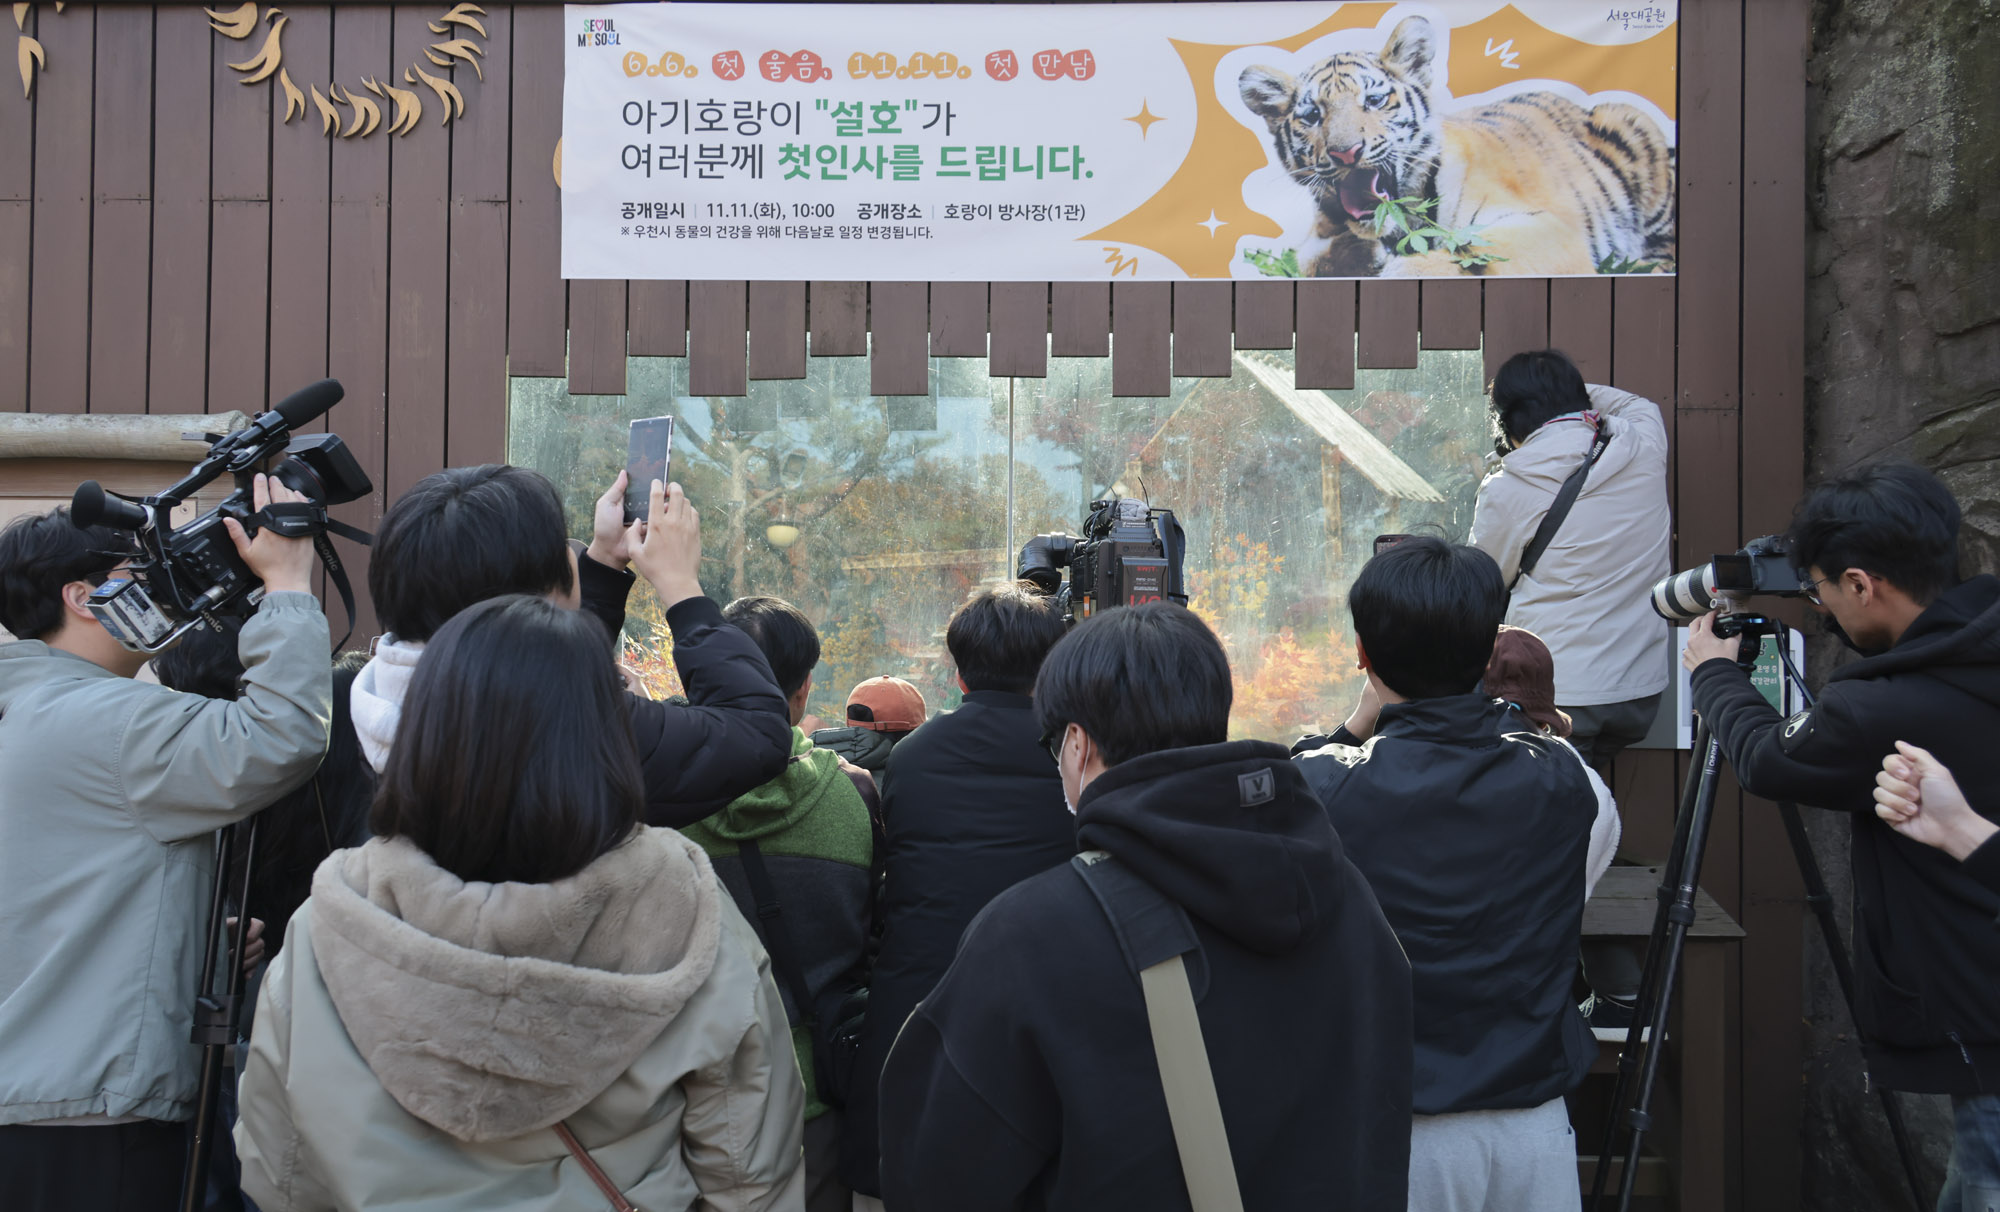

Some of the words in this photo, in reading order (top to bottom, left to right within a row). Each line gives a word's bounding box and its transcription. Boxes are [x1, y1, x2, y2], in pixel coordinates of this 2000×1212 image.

[1606, 7, 1666, 31] 서울대공원
[626, 53, 695, 75] 6.6.
[715, 53, 741, 79] 첫
[763, 52, 830, 80] 울음,
[852, 54, 968, 76] 11.11.
[988, 52, 1014, 79] 첫
[1037, 52, 1093, 79] 만남
[623, 98, 801, 137] 아기호랑이
[815, 98, 957, 138] "설호"가
[621, 143, 764, 180] 여러분께
[777, 143, 924, 181] 첫인사를
[935, 144, 1094, 182] 드립니다.
[620, 202, 685, 220] 공개일시
[706, 202, 786, 221] 11.11.(화),
[792, 203, 835, 218] 10:00
[856, 203, 923, 220] 공개장소
[943, 203, 992, 221] 호랑이
[998, 203, 1086, 222] 방사장(1관)
[633, 225, 671, 239] 우천시
[674, 225, 712, 239] 동물의
[715, 225, 753, 239] 건강을
[756, 225, 781, 239] 위해
[784, 225, 835, 239] 다음날로
[838, 225, 863, 240] 일정
[867, 225, 934, 240] 변경됩니다.
